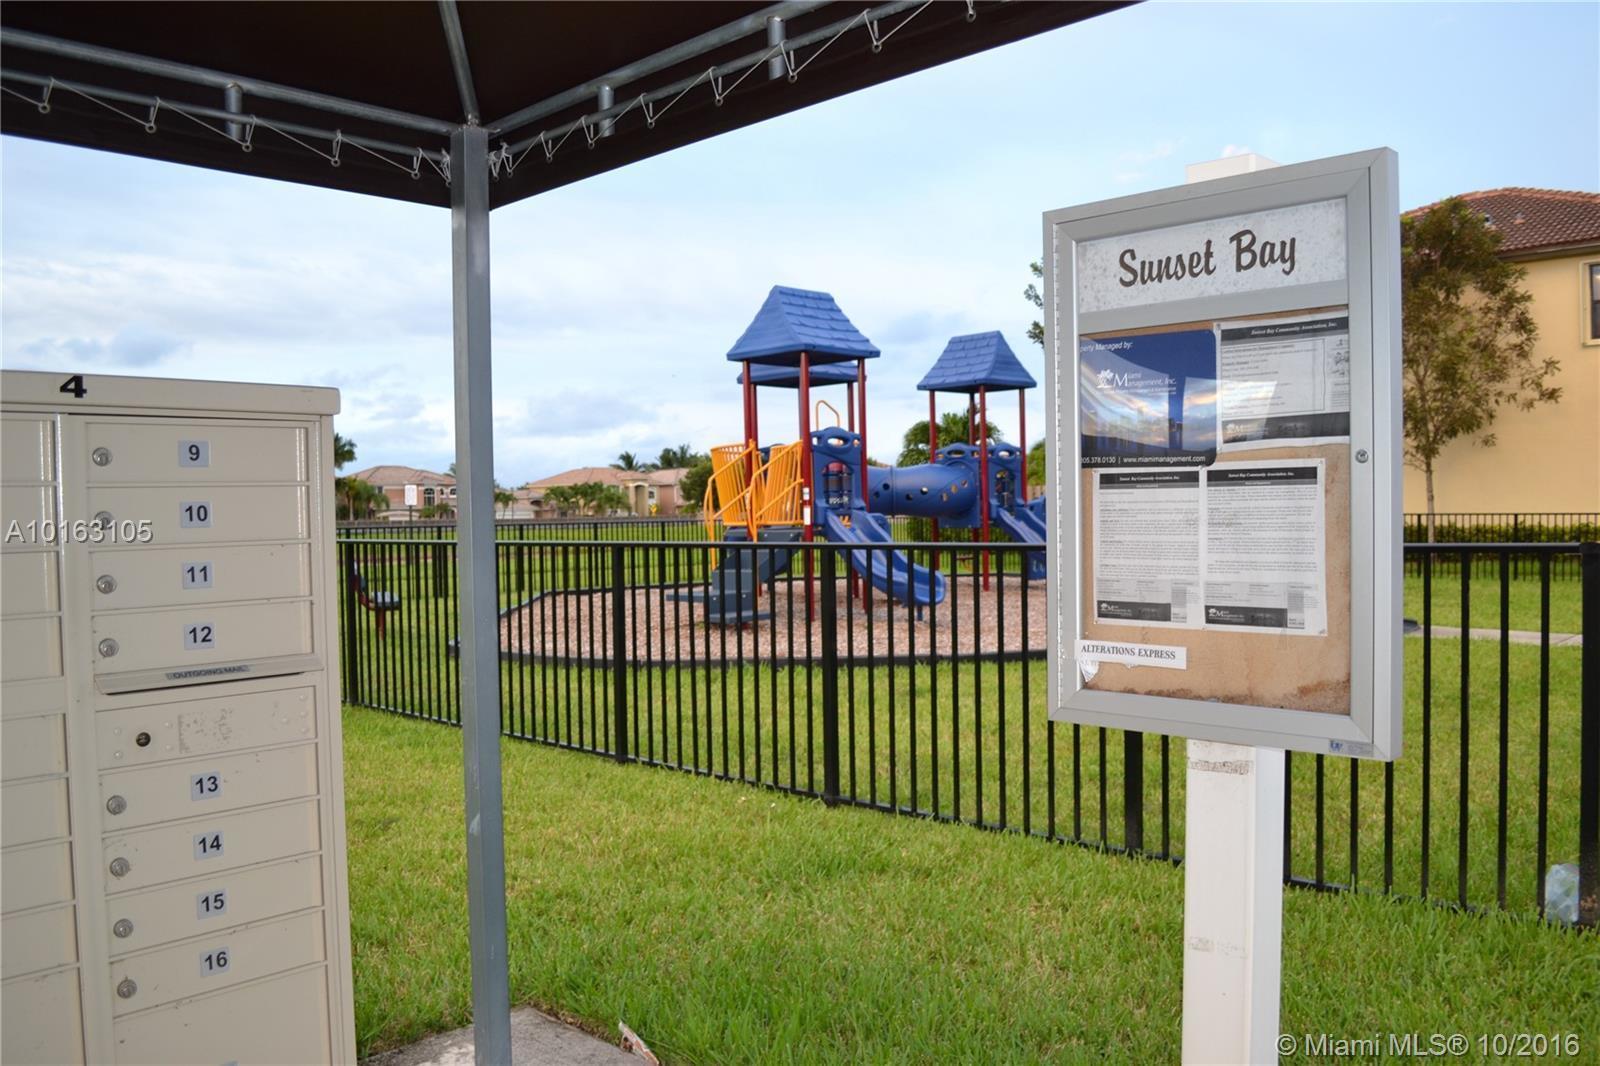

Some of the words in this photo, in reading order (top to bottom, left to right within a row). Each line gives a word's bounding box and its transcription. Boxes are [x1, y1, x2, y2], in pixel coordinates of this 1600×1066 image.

[1119, 239, 1217, 288] Sunset
[1229, 229, 1297, 276] Bay
[1095, 341, 1123, 352] Managed
[59, 375, 87, 398] 4
[188, 444, 201, 461] 9
[1123, 455, 1206, 464] www.miamimanagement.com
[184, 504, 208, 522] 10
[186, 565, 209, 583] 11
[188, 625, 212, 643] 12
[1081, 644, 1136, 656] ALTERATIONS
[1138, 648, 1176, 660] EXPRESS
[173, 668, 223, 679] OUTGOING
[195, 775, 219, 794] 13
[198, 834, 222, 853] 14
[201, 893, 225, 912] 15
[204, 951, 228, 970] 16
